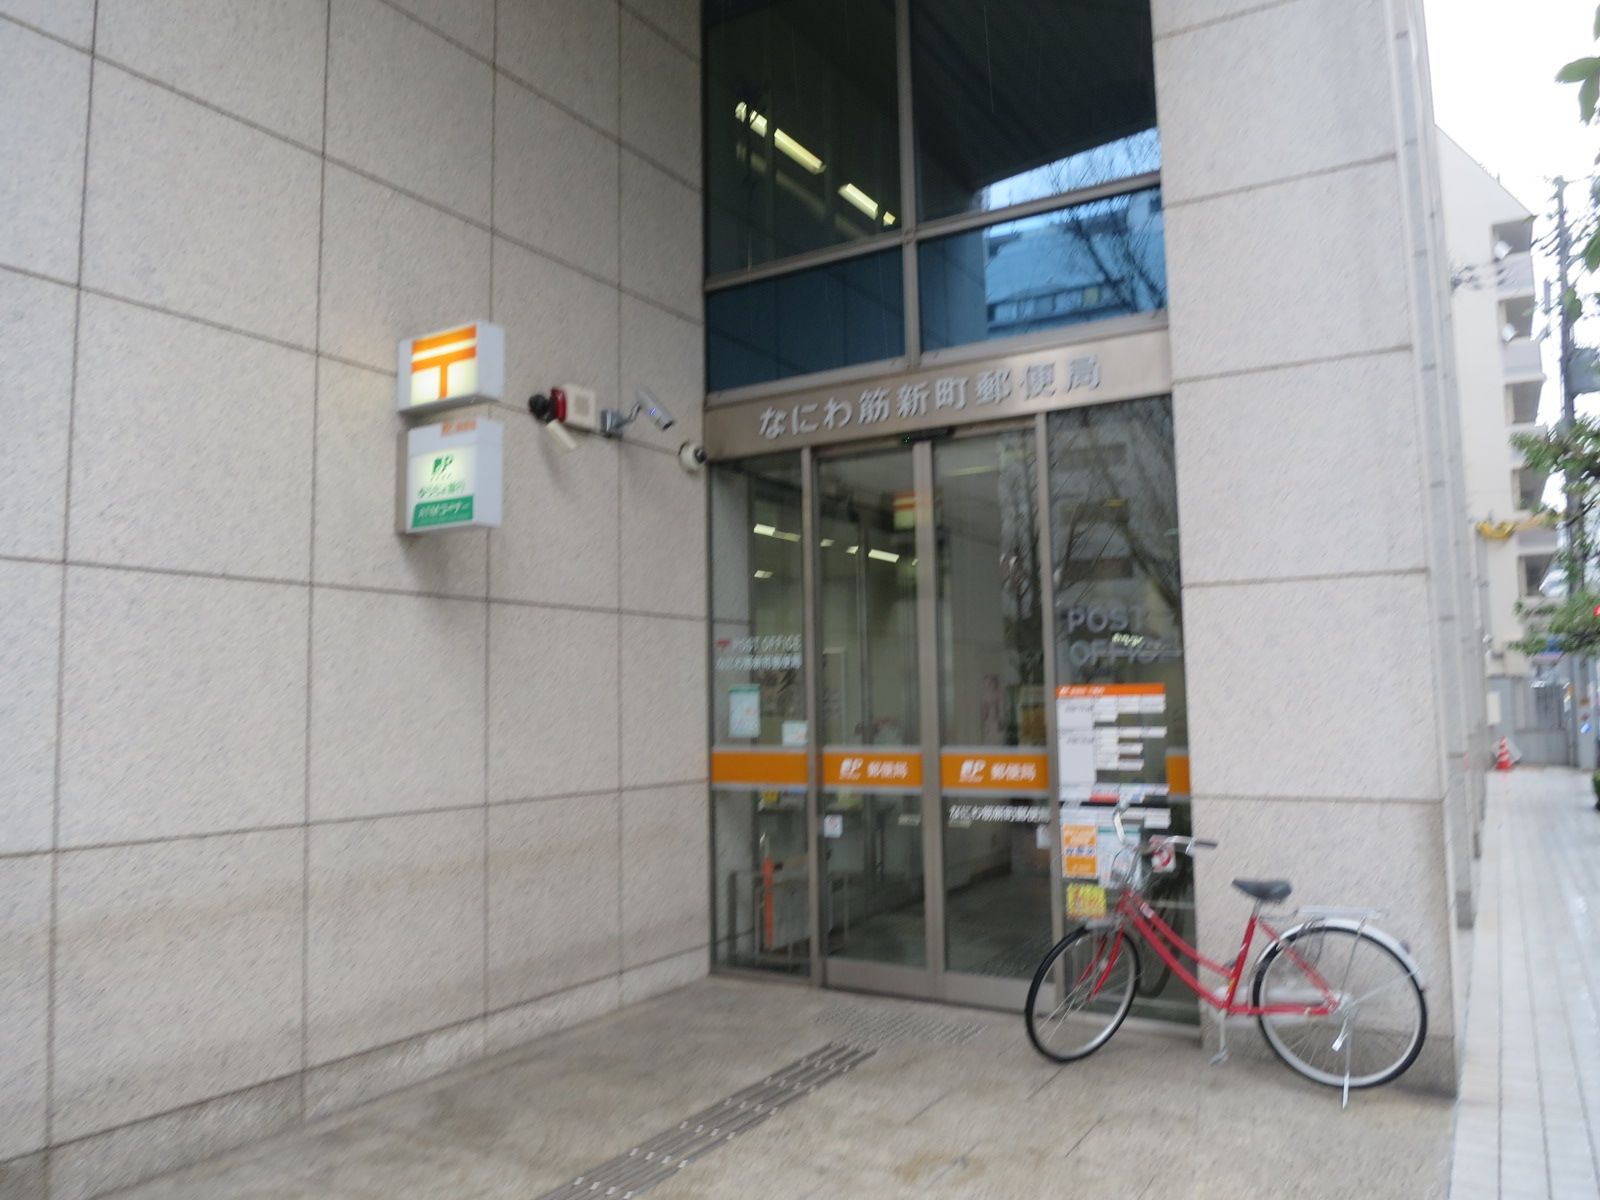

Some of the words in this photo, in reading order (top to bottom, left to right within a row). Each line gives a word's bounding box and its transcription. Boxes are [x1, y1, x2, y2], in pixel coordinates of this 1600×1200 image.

[759, 355, 1101, 440] なにわ筋新町郵便局
[1067, 605, 1142, 634] POST
